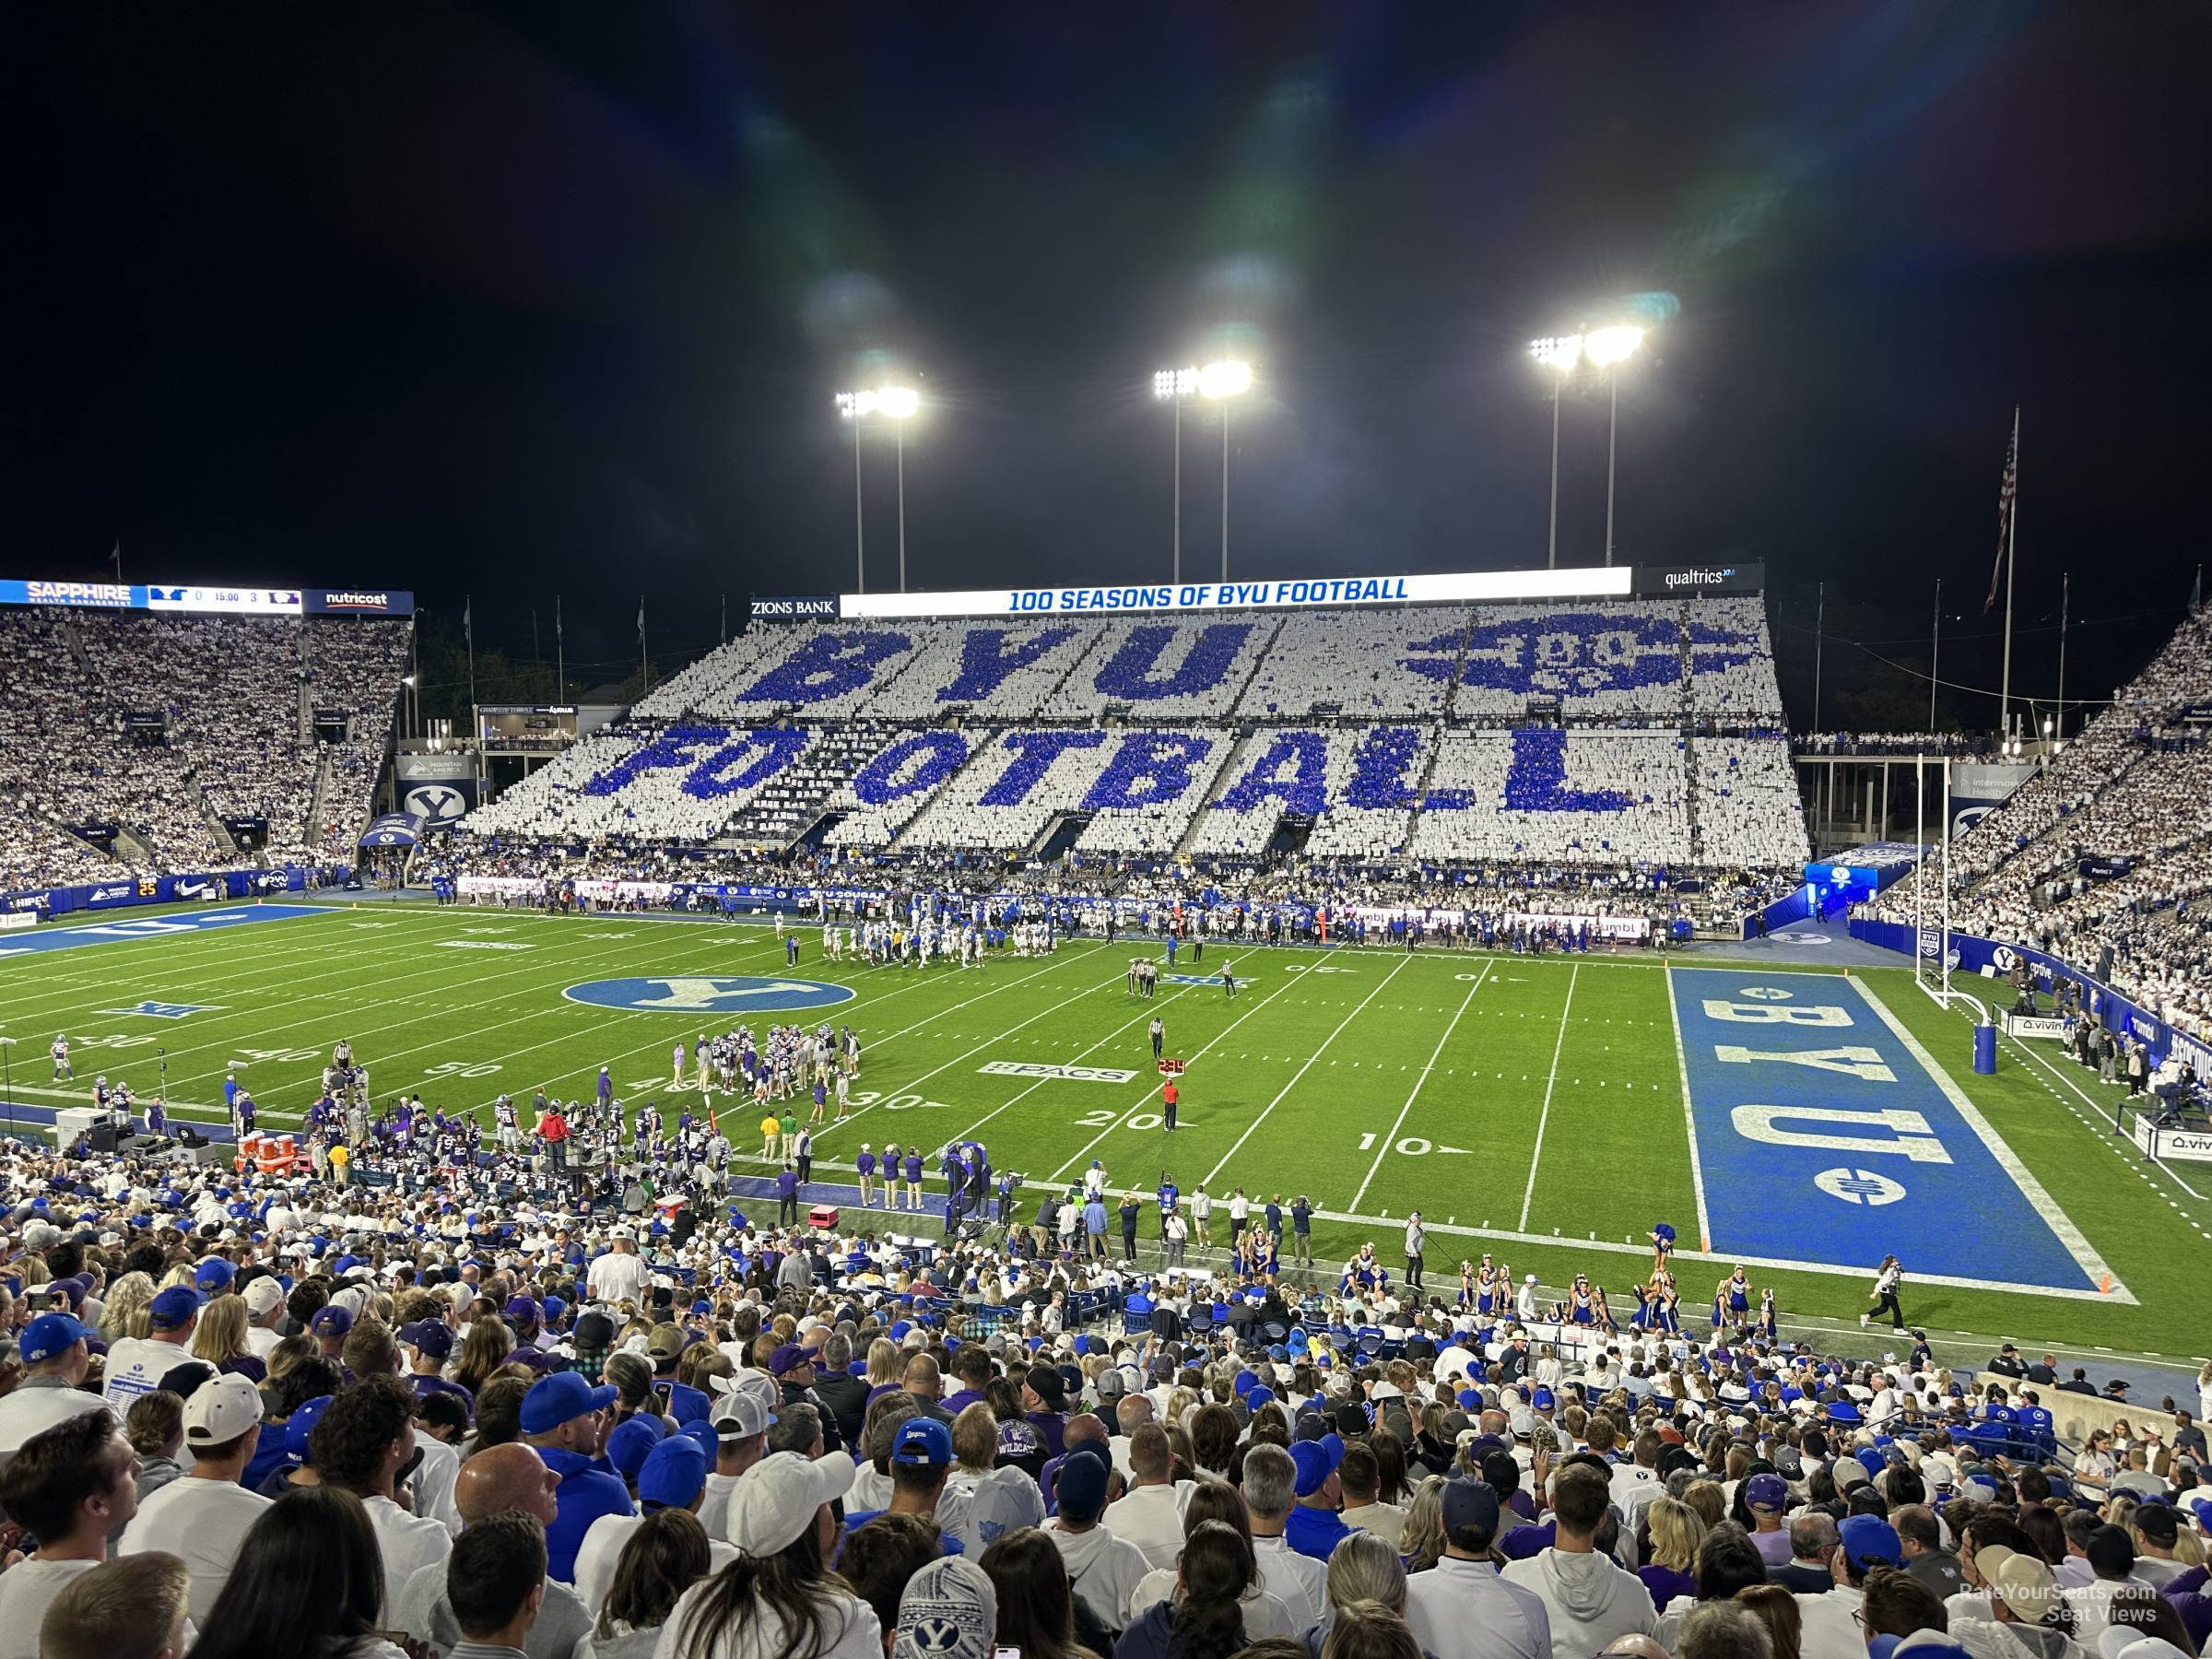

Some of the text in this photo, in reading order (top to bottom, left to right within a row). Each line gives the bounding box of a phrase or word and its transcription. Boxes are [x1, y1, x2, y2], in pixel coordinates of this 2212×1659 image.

[1665, 570, 1723, 590] qualtrics
[28, 582, 131, 600] SAPPHIRE
[250, 593, 257, 603] 3
[1009, 578, 1409, 611] 100 SEASONS OF BYU FOOTBALL
[326, 593, 387, 605] nutricost
[751, 601, 834, 616] ZIONS BANK
[735, 624, 1253, 701] BYU
[584, 724, 1637, 811] FOOTBALL
[1972, 779, 2018, 787] Intermou
[1972, 787, 2003, 796] Health
[138, 883, 157, 896] 25
[1602, 923, 1636, 933] umbl
[81, 1034, 158, 1048] 30
[245, 1048, 323, 1062] 40
[424, 1062, 504, 1077] 50
[1014, 1065, 1126, 1080] PACS
[1701, 999, 1955, 1165] BYU
[848, 1091, 924, 1110] 30
[1075, 1111, 1164, 1130] 20
[454, 1147, 467, 1156] 23
[1359, 1133, 1432, 1157] 10
[501, 1171, 517, 1181] 57
